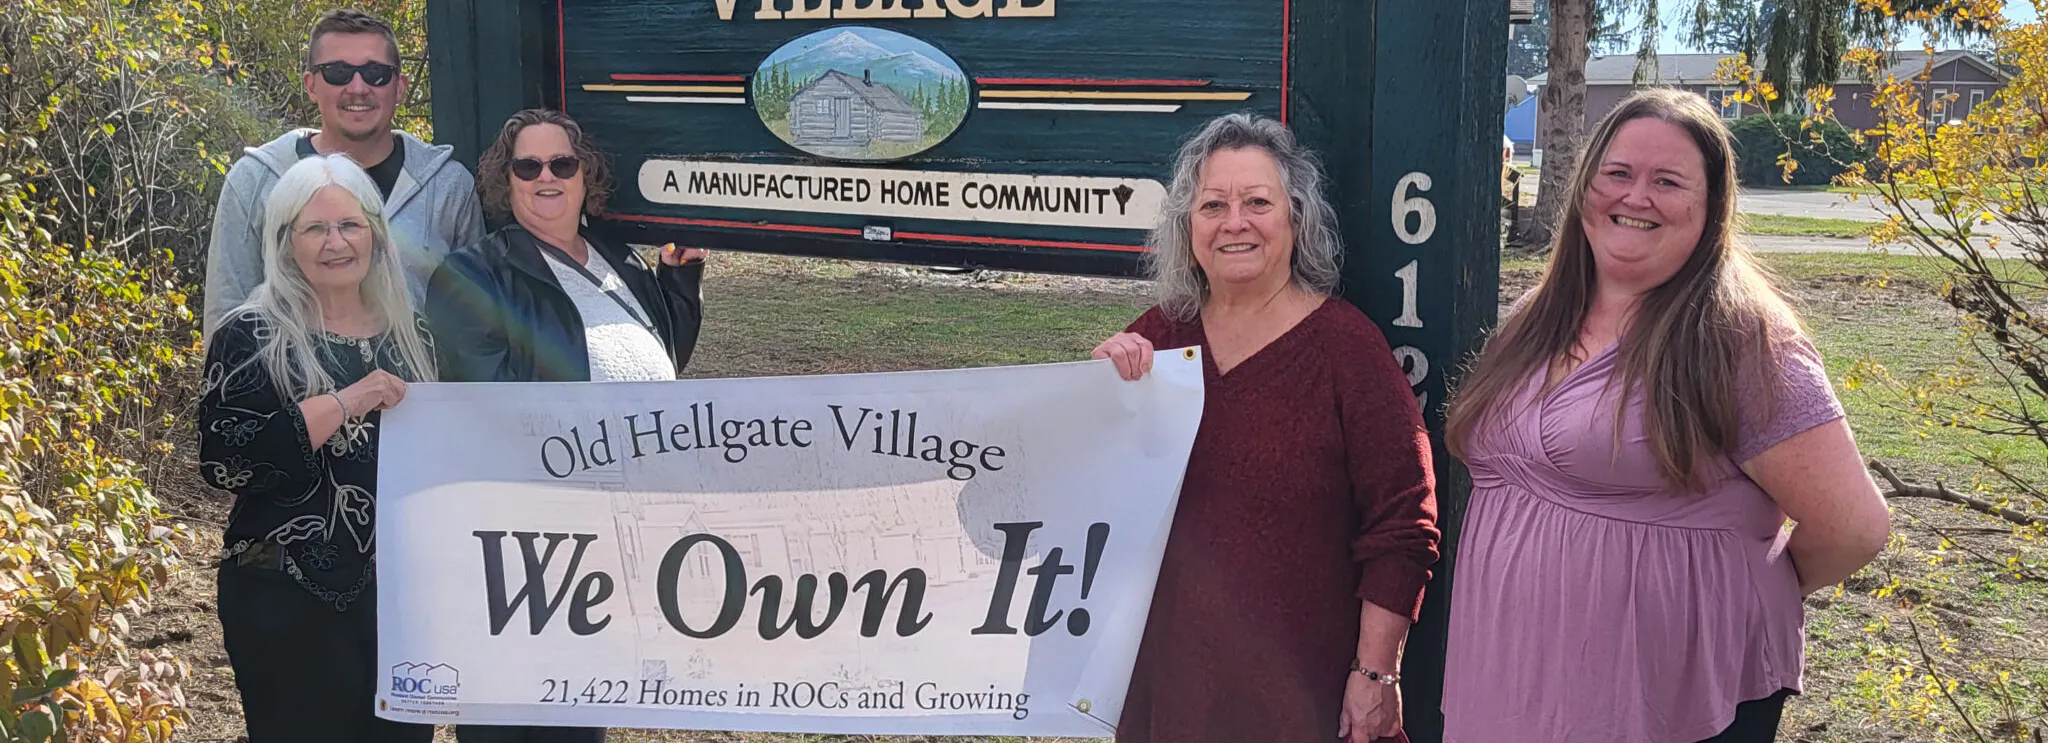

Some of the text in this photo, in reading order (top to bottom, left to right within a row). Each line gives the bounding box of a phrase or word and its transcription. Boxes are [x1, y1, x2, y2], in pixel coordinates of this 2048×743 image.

[663, 171, 1134, 216] A MANUFACTURED HOME COMMUNITY
[541, 402, 1006, 481] Old Hellgate Village
[472, 521, 1111, 641] We Own It!
[391, 676, 431, 694] ROC
[540, 678, 1032, 721] 21,422 Homes in ROCs and Growing
